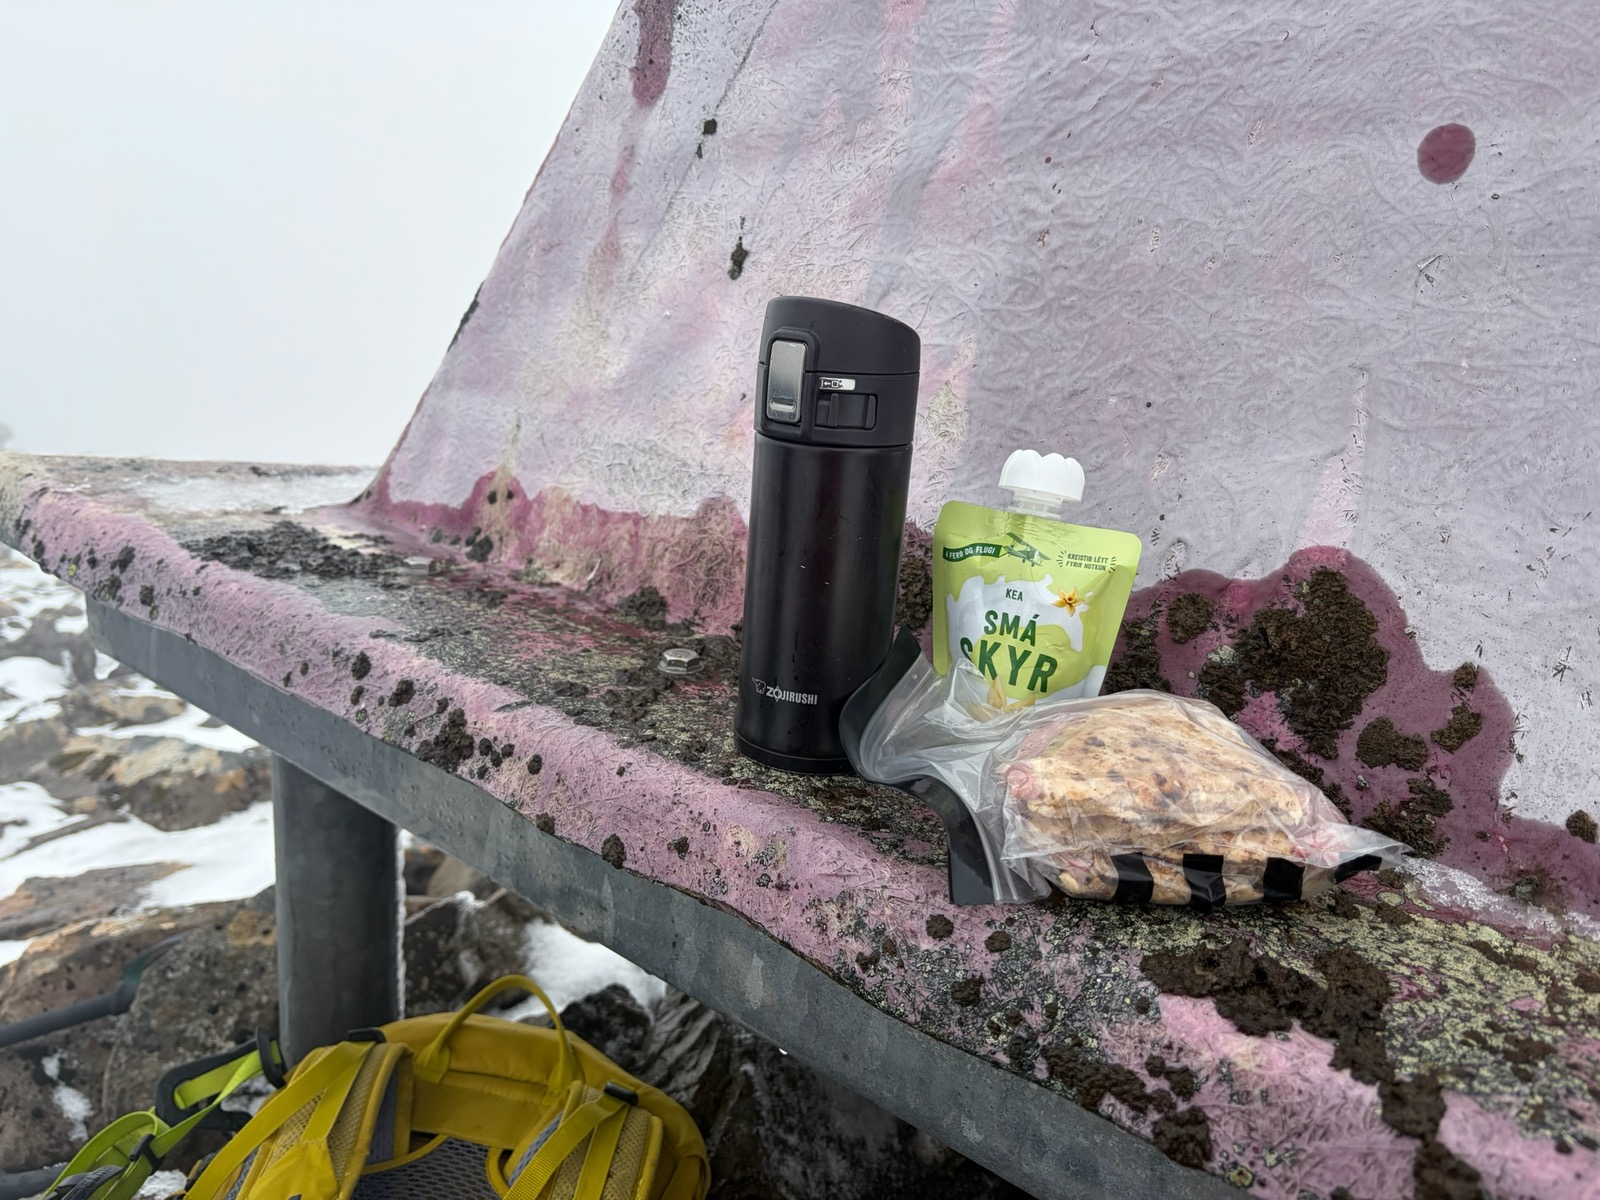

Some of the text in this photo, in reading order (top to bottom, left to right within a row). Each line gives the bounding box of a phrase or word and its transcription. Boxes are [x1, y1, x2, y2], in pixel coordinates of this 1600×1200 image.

[964, 547, 974, 556] OG
[1005, 588, 1023, 601] KEA
[983, 610, 1040, 647] SMÁ
[765, 685, 818, 705] ZOJIRUSHI
